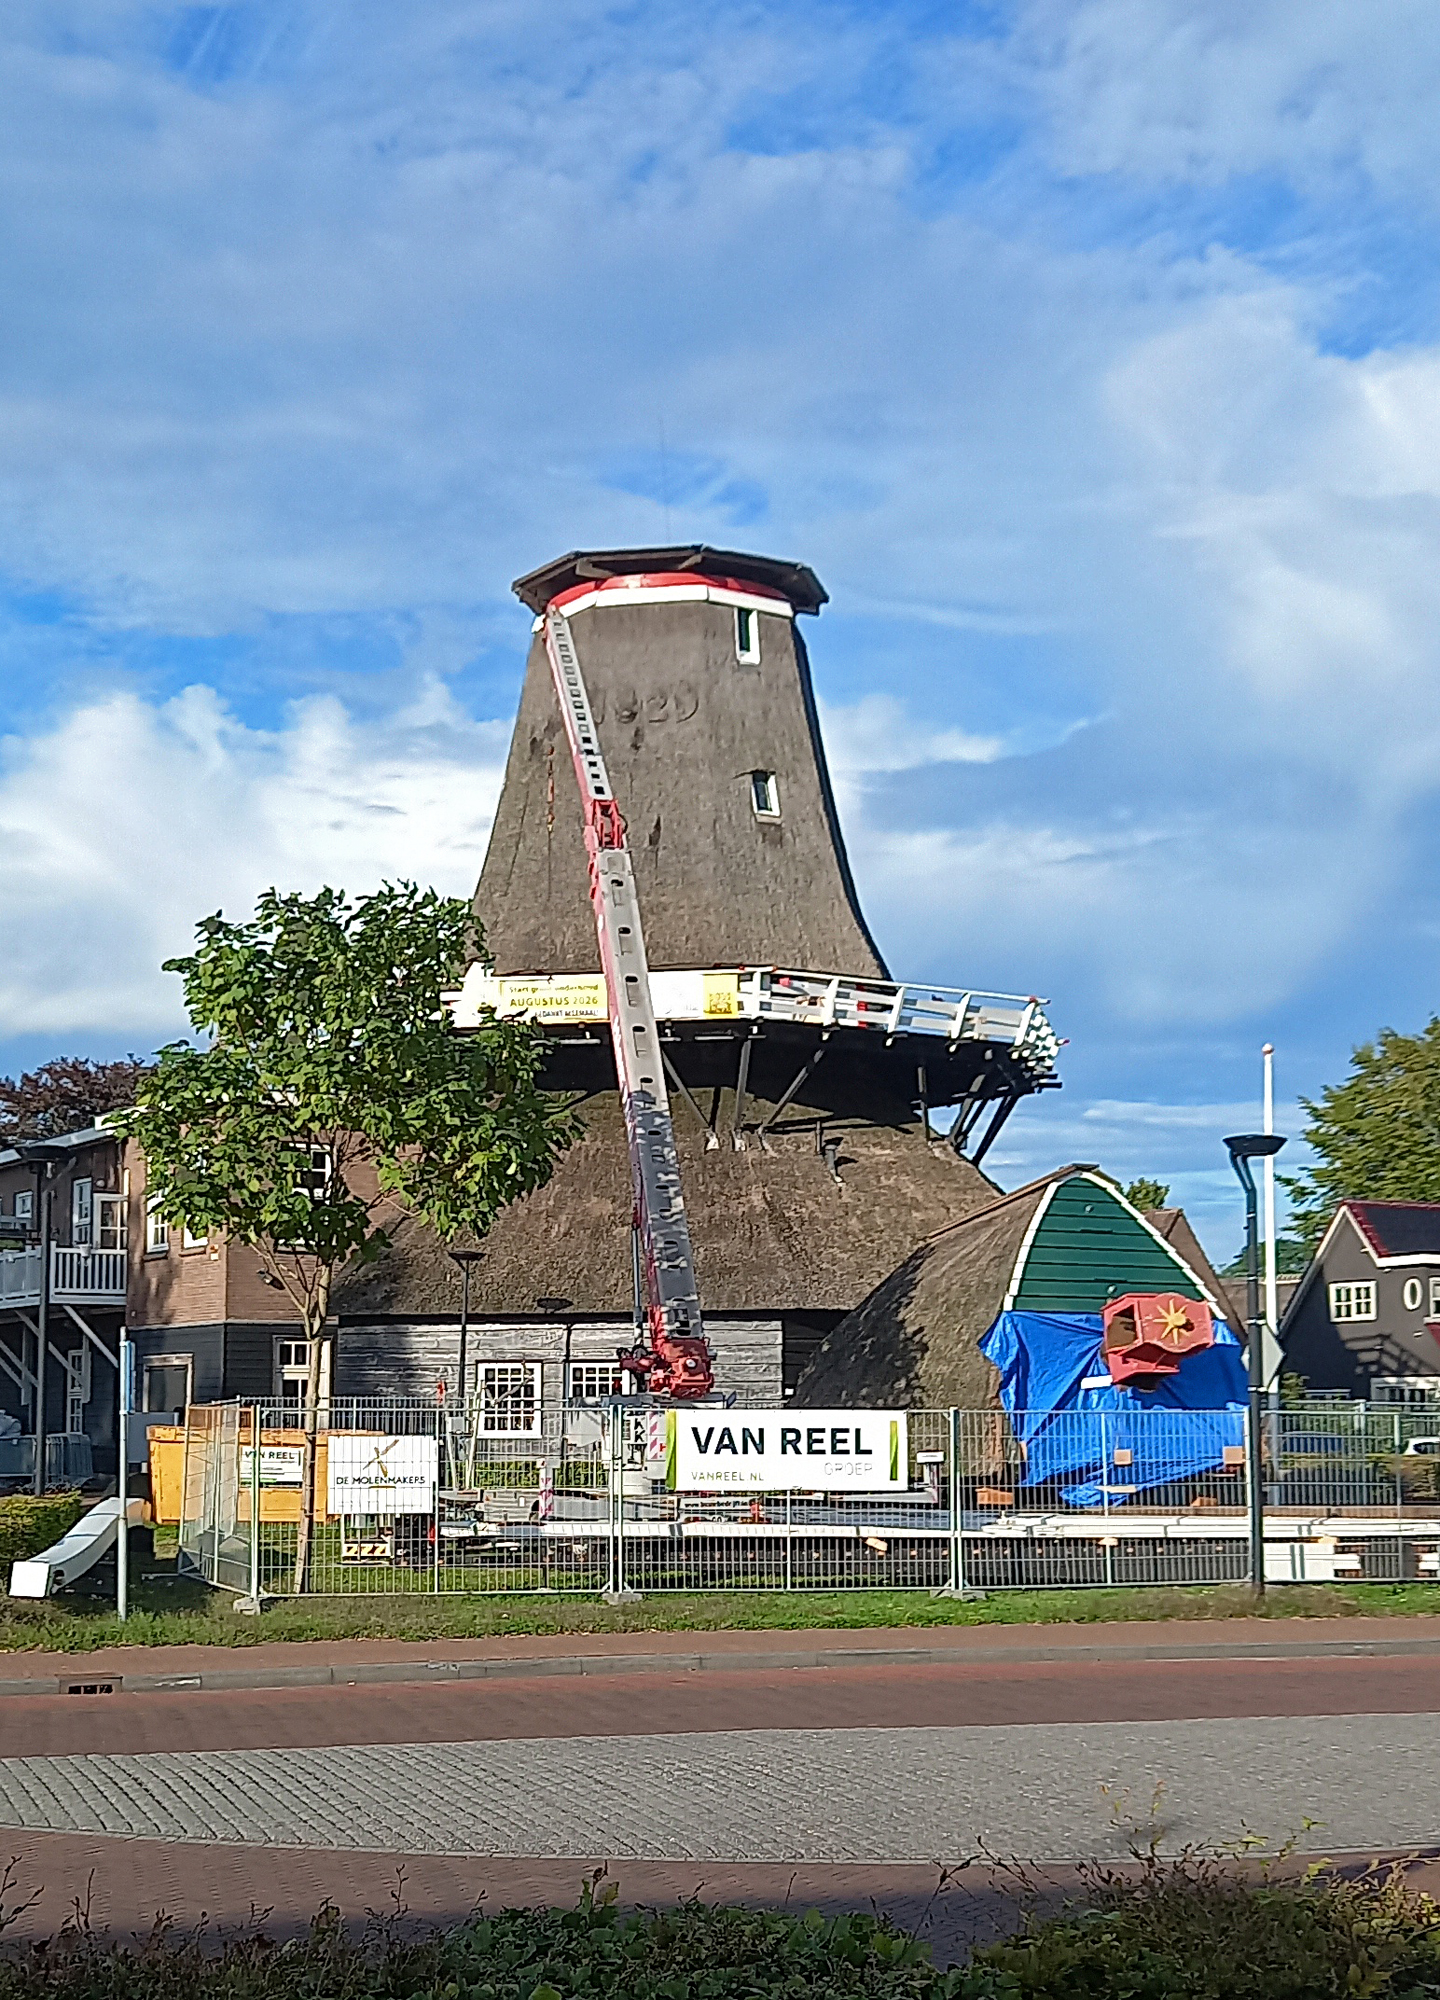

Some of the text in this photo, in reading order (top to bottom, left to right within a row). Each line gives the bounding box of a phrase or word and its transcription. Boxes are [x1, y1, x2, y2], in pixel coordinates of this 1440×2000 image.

[510, 996, 598, 1007] AUGUSTUS 2026
[690, 1426, 873, 1455] VAN REEL
[268, 1451, 295, 1460] REEL
[824, 1462, 874, 1477] GROEP
[336, 1475, 426, 1485] DE MOLENMAKERS
[690, 1470, 765, 1482] VANREEL.NL
